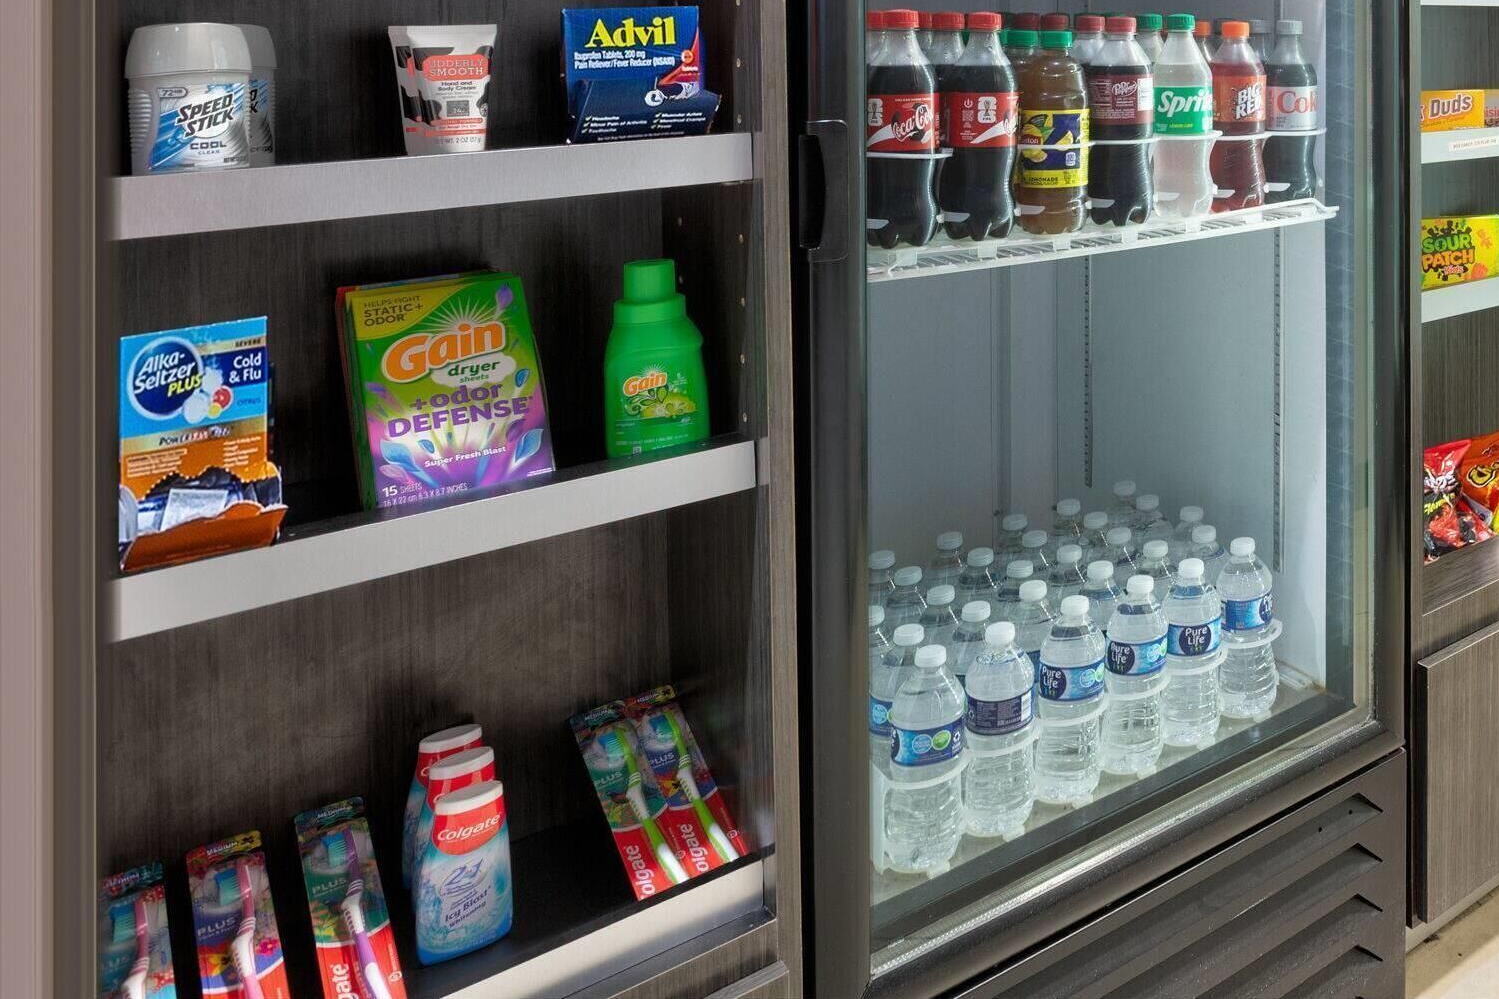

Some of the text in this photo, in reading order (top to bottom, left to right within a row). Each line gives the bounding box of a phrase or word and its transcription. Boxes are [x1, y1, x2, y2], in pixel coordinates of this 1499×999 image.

[585, 17, 676, 48] Advil
[574, 61, 588, 69] Pain
[629, 58, 652, 67] Reducer
[624, 50, 636, 59] 200
[636, 51, 646, 60] mg
[429, 68, 484, 77] SMOOTH
[1237, 82, 1262, 103] BIG
[177, 93, 234, 124] SPEED
[1430, 93, 1473, 118] Duds
[184, 107, 234, 138] STICK
[189, 141, 227, 150] COOL
[1422, 233, 1472, 253] SOUR
[1422, 248, 1475, 270] PATCH
[364, 304, 413, 318] STATIC
[364, 314, 405, 327] ODOR
[233, 353, 262, 369] Cold
[383, 322, 505, 382] Gain
[137, 352, 186, 377] Alka-
[447, 359, 500, 379] dryer
[134, 362, 196, 394] Seltzer
[167, 374, 202, 397] PLUS
[228, 369, 262, 383] & Flu
[459, 374, 490, 384] sheets
[623, 372, 668, 396] Gain
[387, 397, 530, 438] DEFENSE
[424, 446, 507, 468] Super Fresh Blast
[382, 485, 398, 497] 15
[1185, 626, 1208, 639] Pure
[1187, 635, 1205, 646] Life
[1110, 641, 1131, 655] Pure
[1111, 652, 1127, 663] Life
[1041, 665, 1062, 679] Pure
[1043, 676, 1059, 689] Life
[437, 813, 502, 842] Colgate
[680, 823, 709, 872] olgate
[624, 844, 657, 899] olgate
[311, 876, 348, 894] PLUS
[197, 915, 236, 937] PLUS
